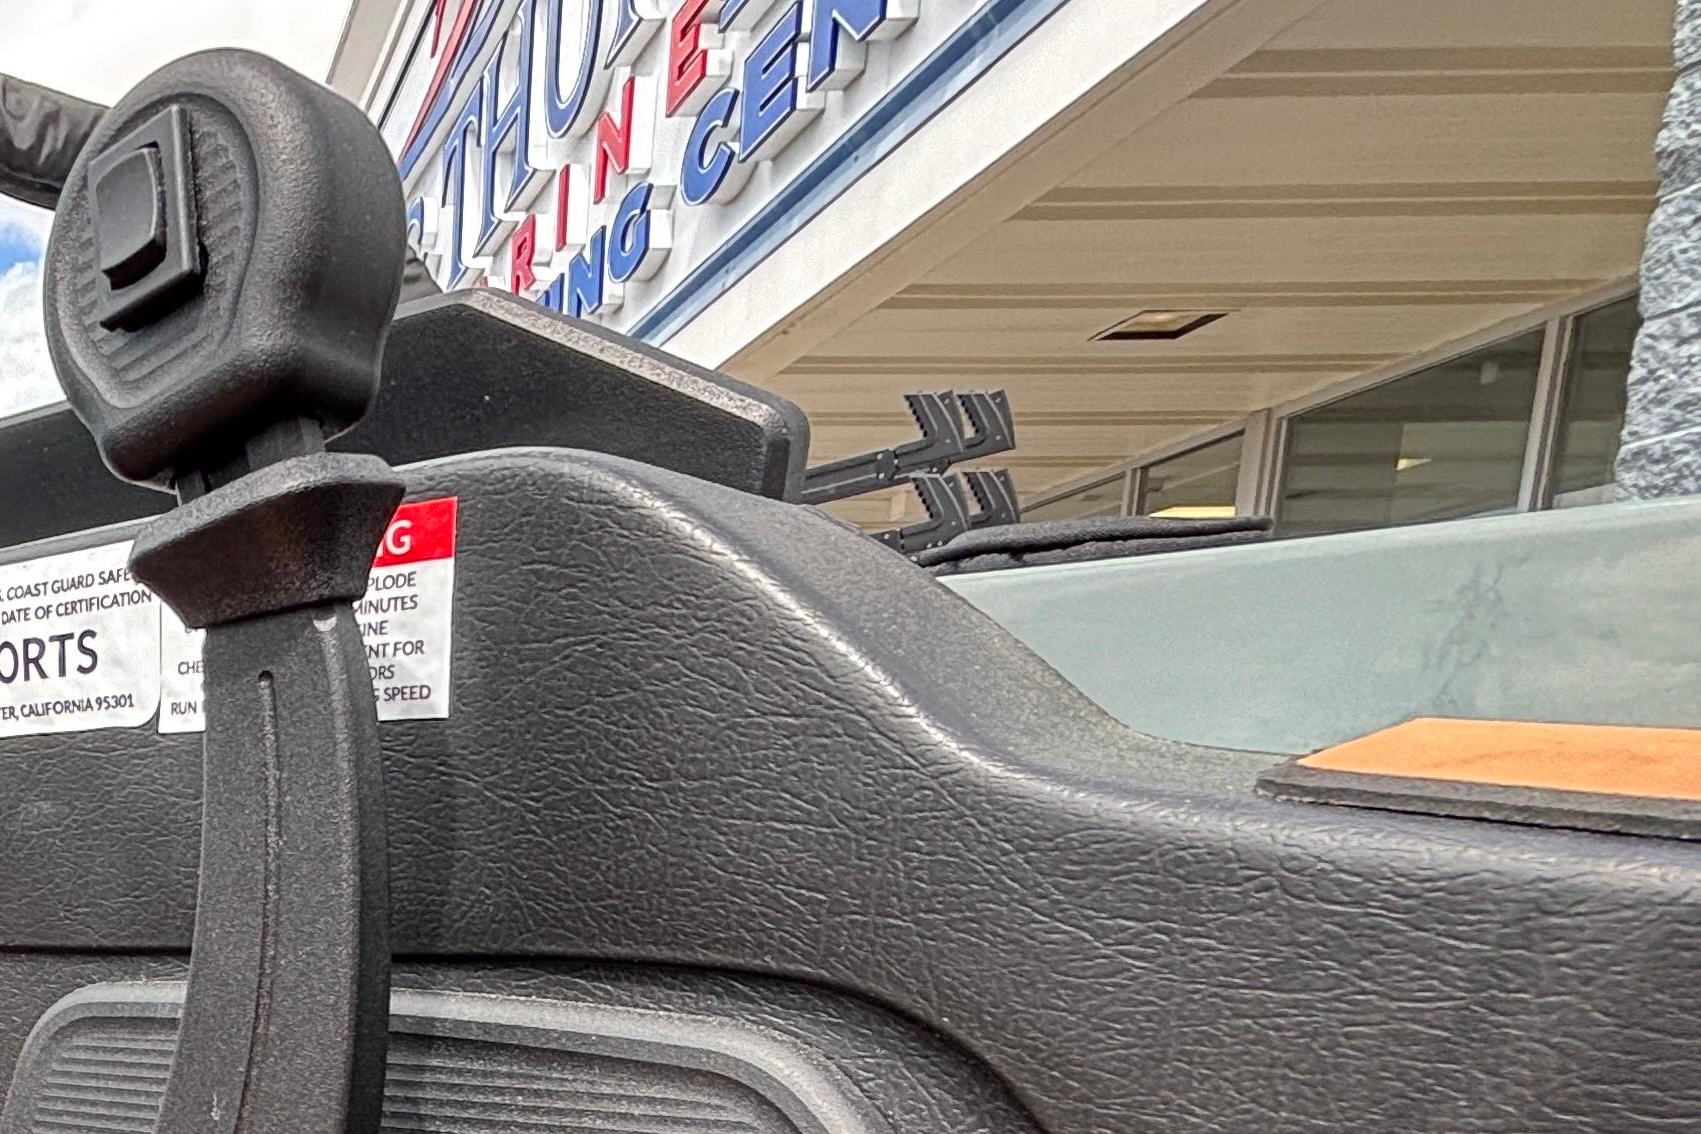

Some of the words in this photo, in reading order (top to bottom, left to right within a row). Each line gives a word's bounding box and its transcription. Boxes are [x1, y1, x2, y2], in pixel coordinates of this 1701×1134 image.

[7, 582, 49, 601] COAST
[51, 573, 95, 594] GUARD
[98, 568, 133, 585] SAFE
[1, 607, 31, 625] DATE
[34, 604, 53, 620] OF
[55, 589, 152, 617] CERTIFICATION
[393, 640, 425, 658] FOR
[20, 696, 93, 718] CALIFORNIA
[95, 693, 135, 711] 95301
[171, 701, 197, 715] RUN
[384, 684, 431, 702] SPEED
